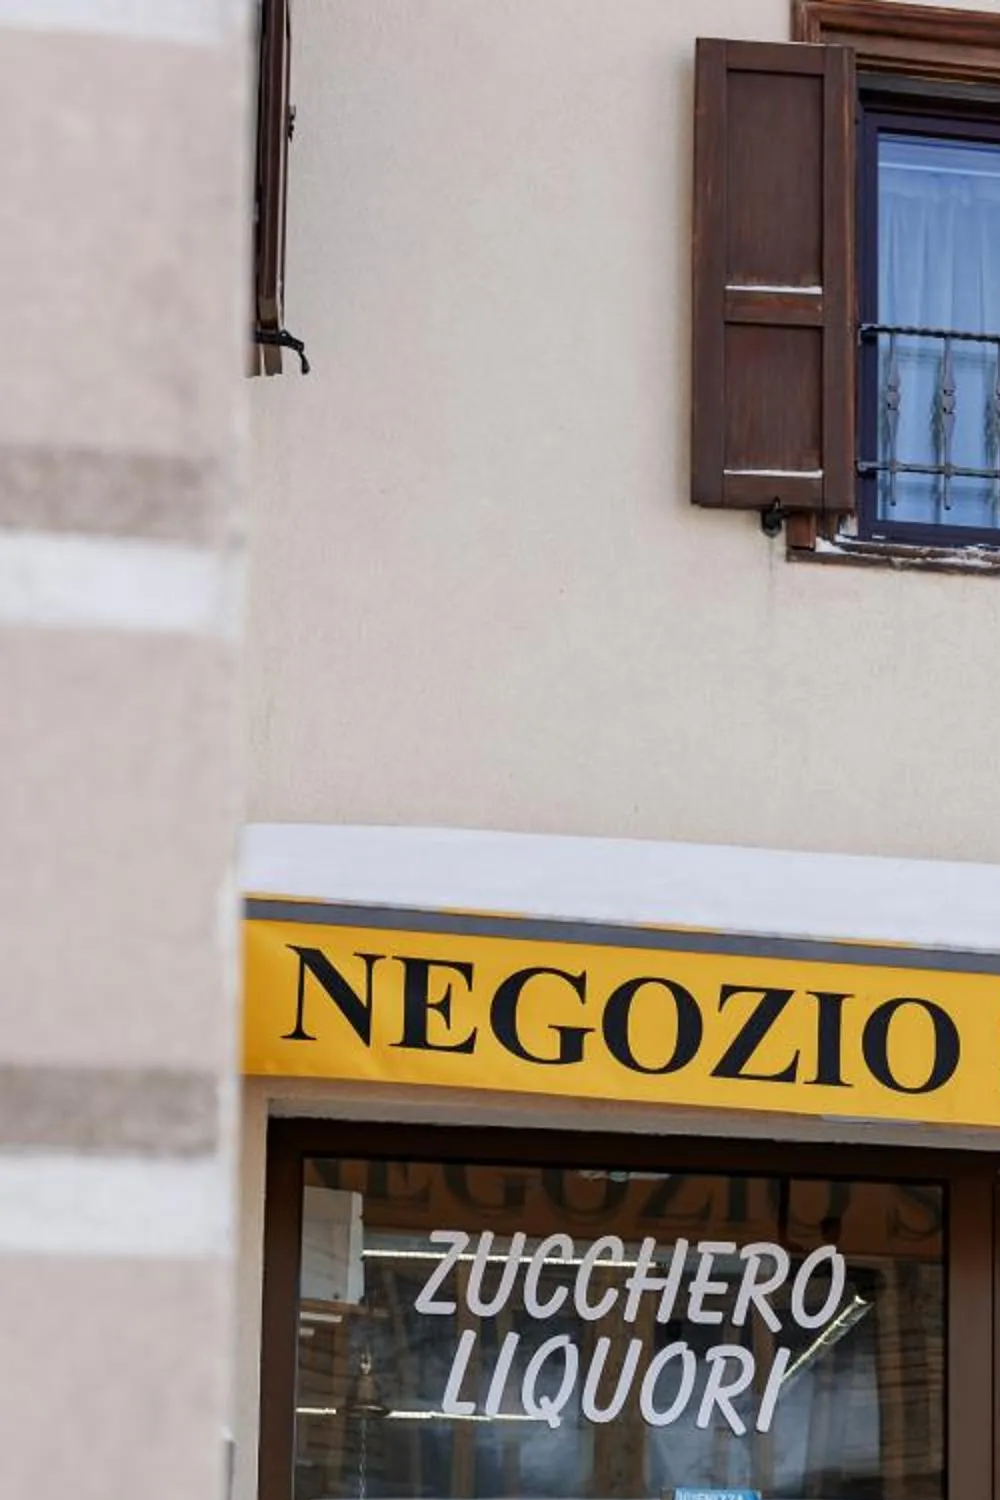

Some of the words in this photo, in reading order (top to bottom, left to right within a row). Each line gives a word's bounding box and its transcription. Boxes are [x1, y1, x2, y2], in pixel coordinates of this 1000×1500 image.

[280, 943, 961, 1095] NEGOZIO
[414, 1229, 846, 1332] ZUCCHERO
[441, 1328, 794, 1436] LIQUORI
